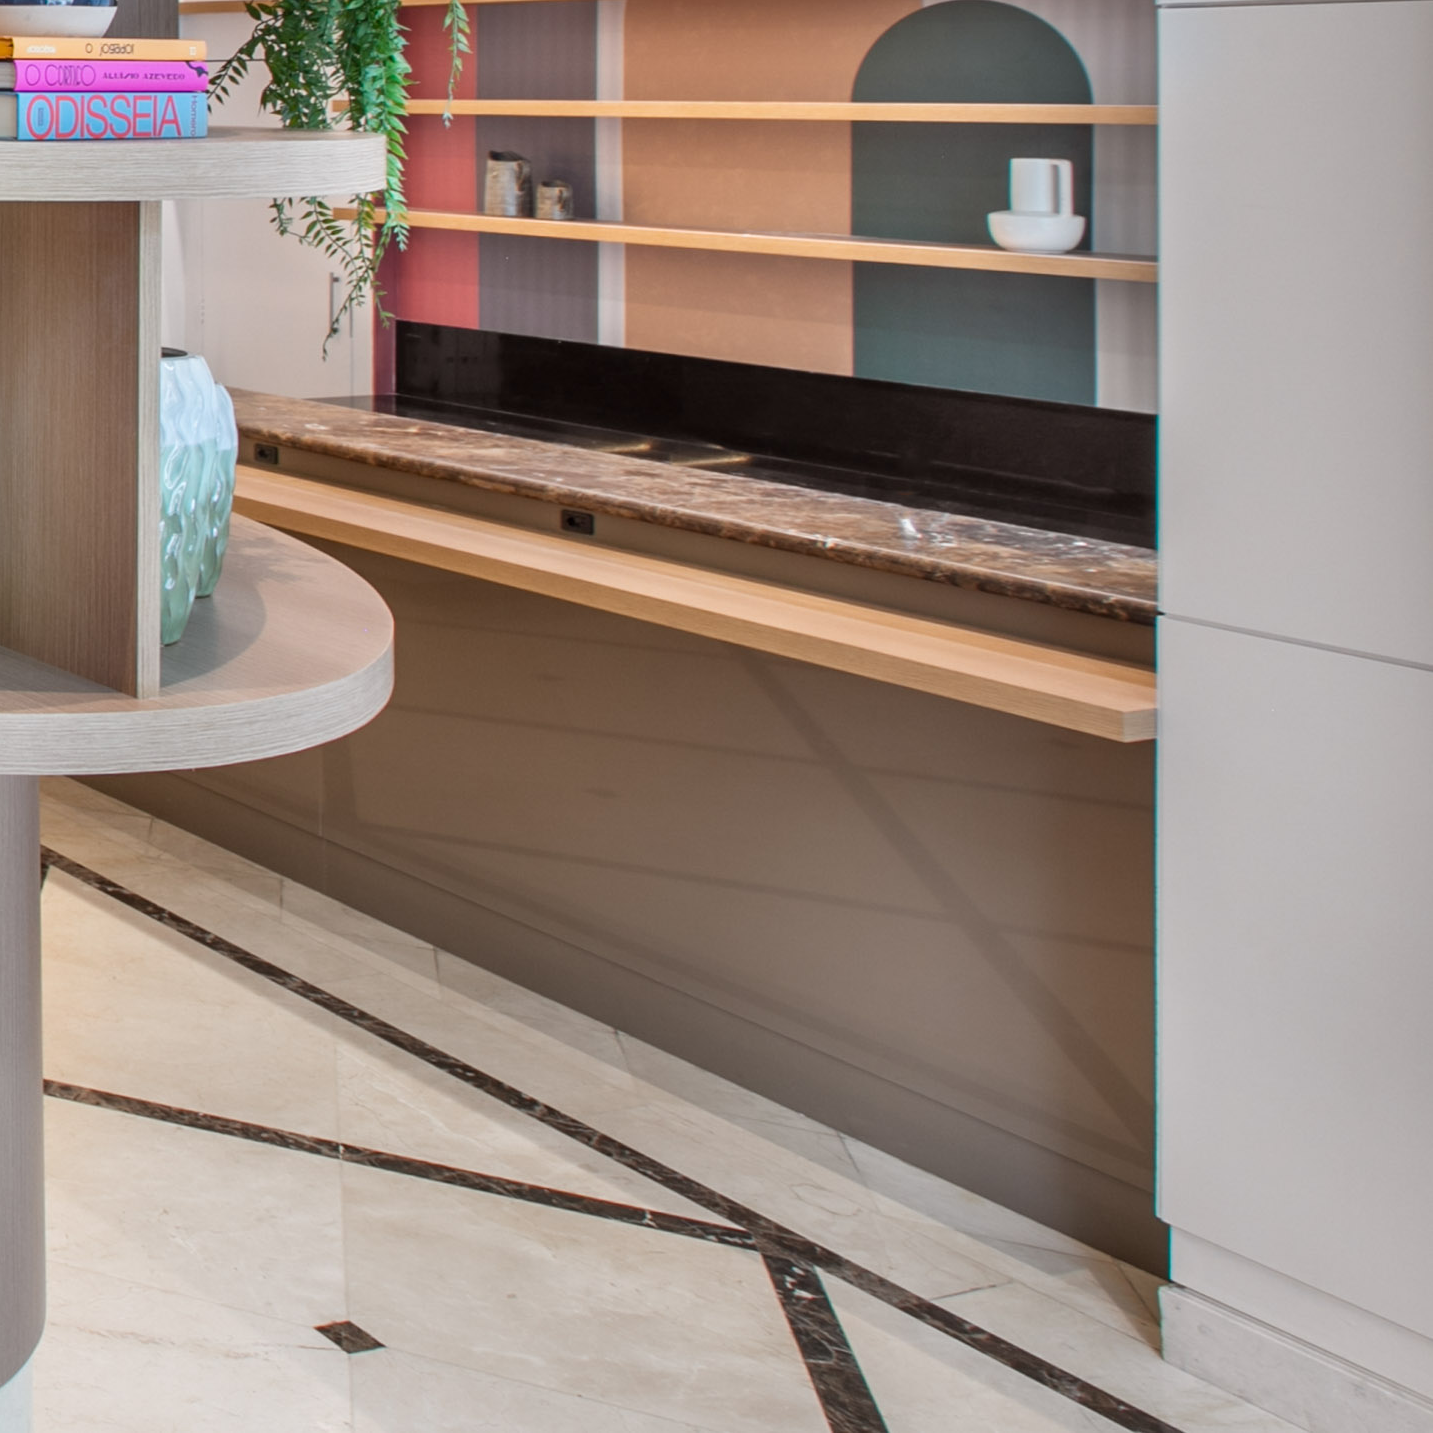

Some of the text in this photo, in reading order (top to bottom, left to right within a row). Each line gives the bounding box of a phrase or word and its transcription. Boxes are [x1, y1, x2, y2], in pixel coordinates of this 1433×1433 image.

[85, 43, 94, 54] O
[25, 63, 41, 87] O
[142, 72, 186, 81] AZEVEDO
[26, 94, 183, 140] ODISSEIA
[188, 95, 198, 137] Homero
